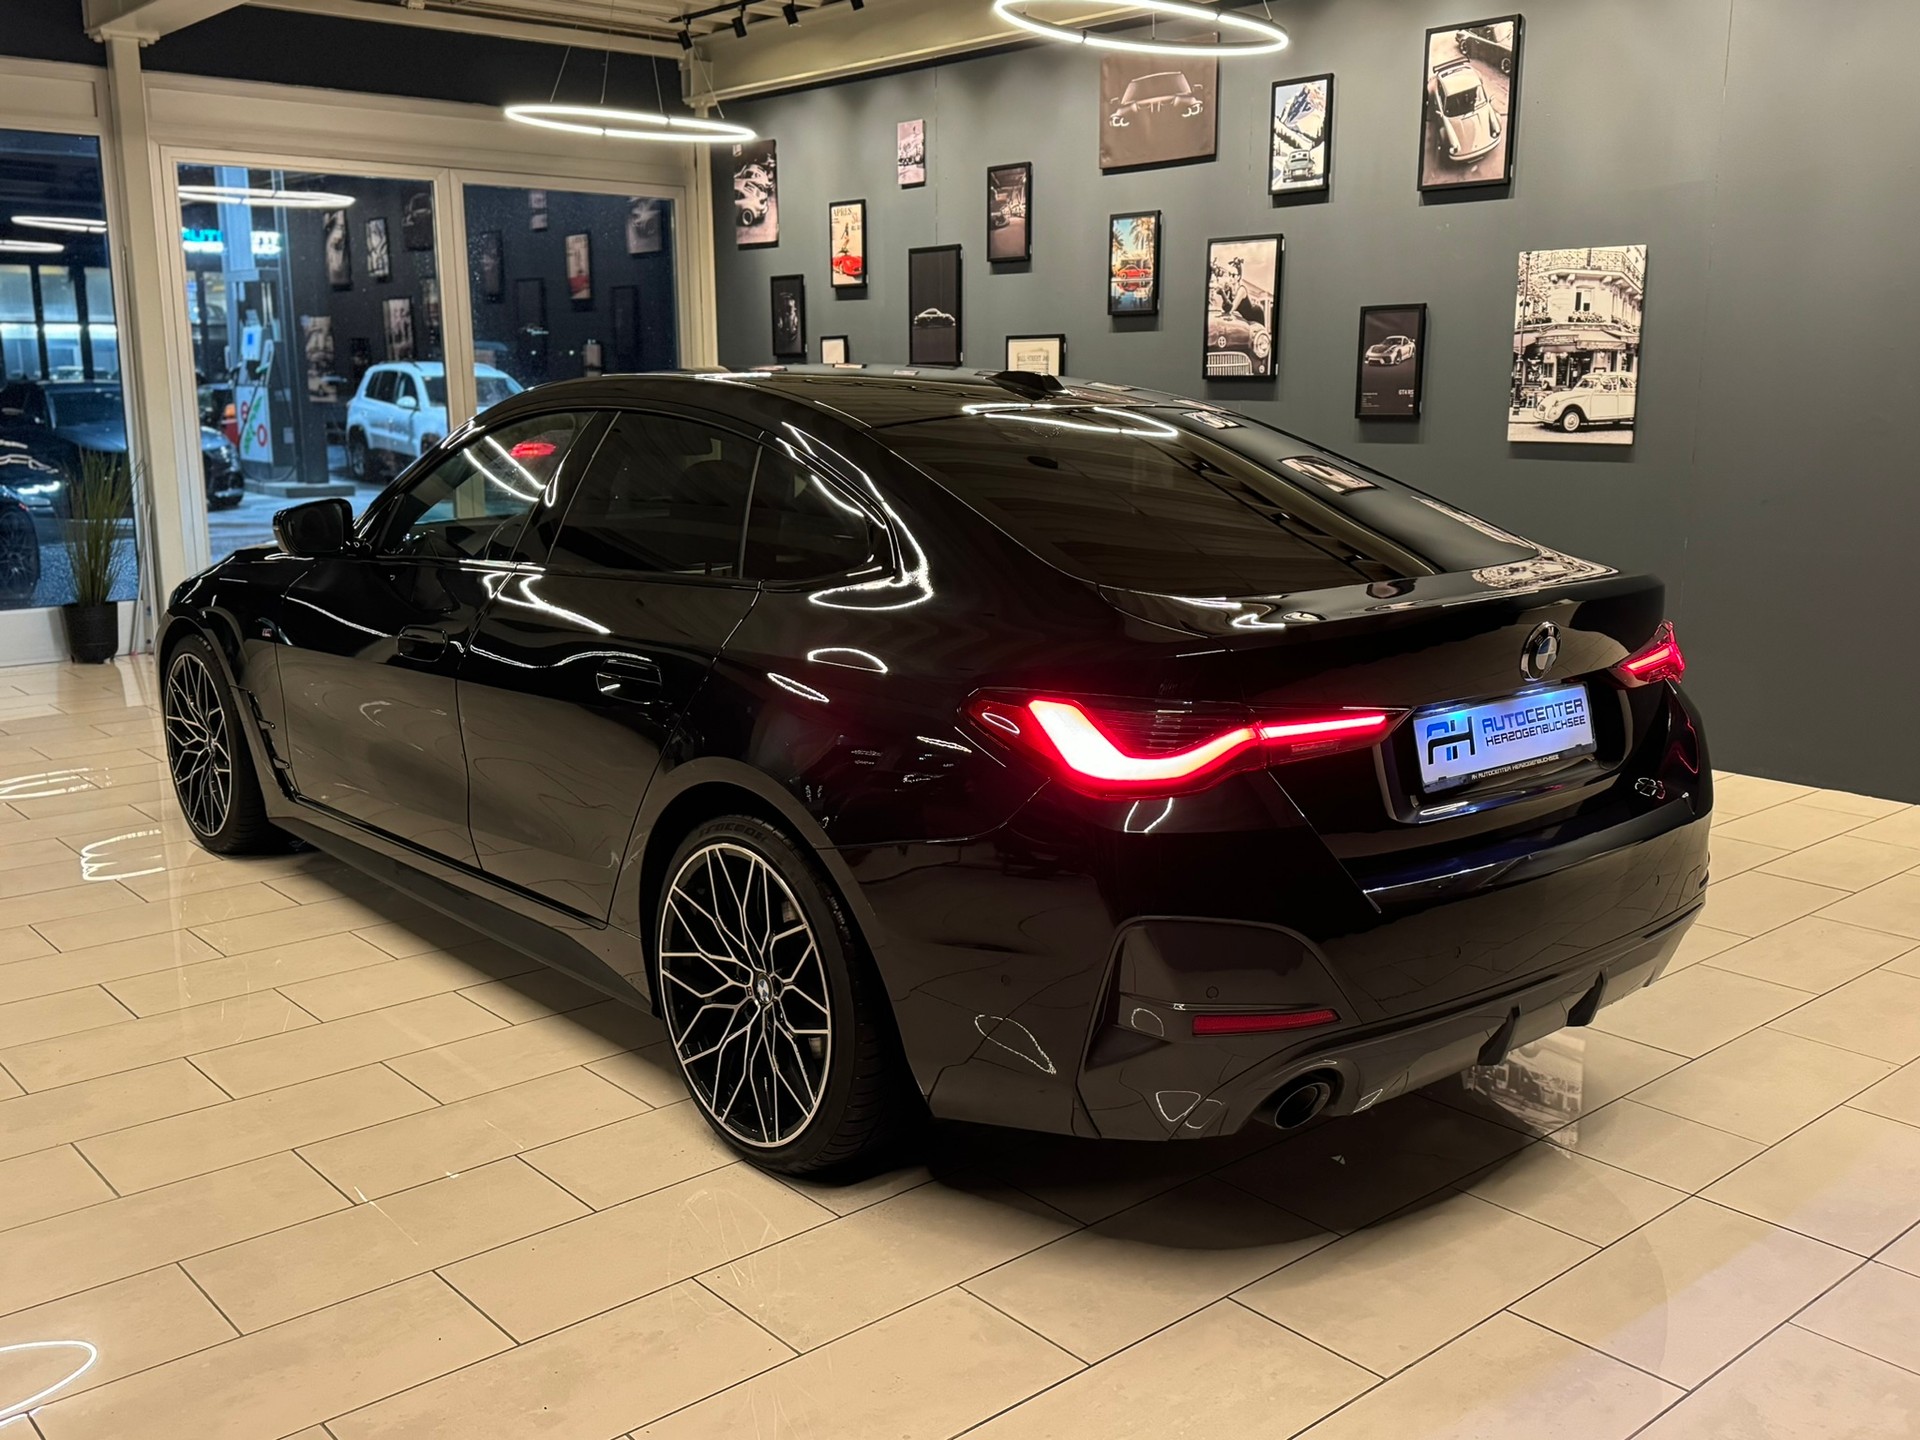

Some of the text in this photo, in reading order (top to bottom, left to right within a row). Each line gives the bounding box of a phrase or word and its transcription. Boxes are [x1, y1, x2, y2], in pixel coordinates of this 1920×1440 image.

[1482, 698, 1584, 734] AUTOCENTER
[1485, 715, 1586, 746] HERZOGENBUCHSEE
[1479, 766, 1511, 778] AUTOCENTER
